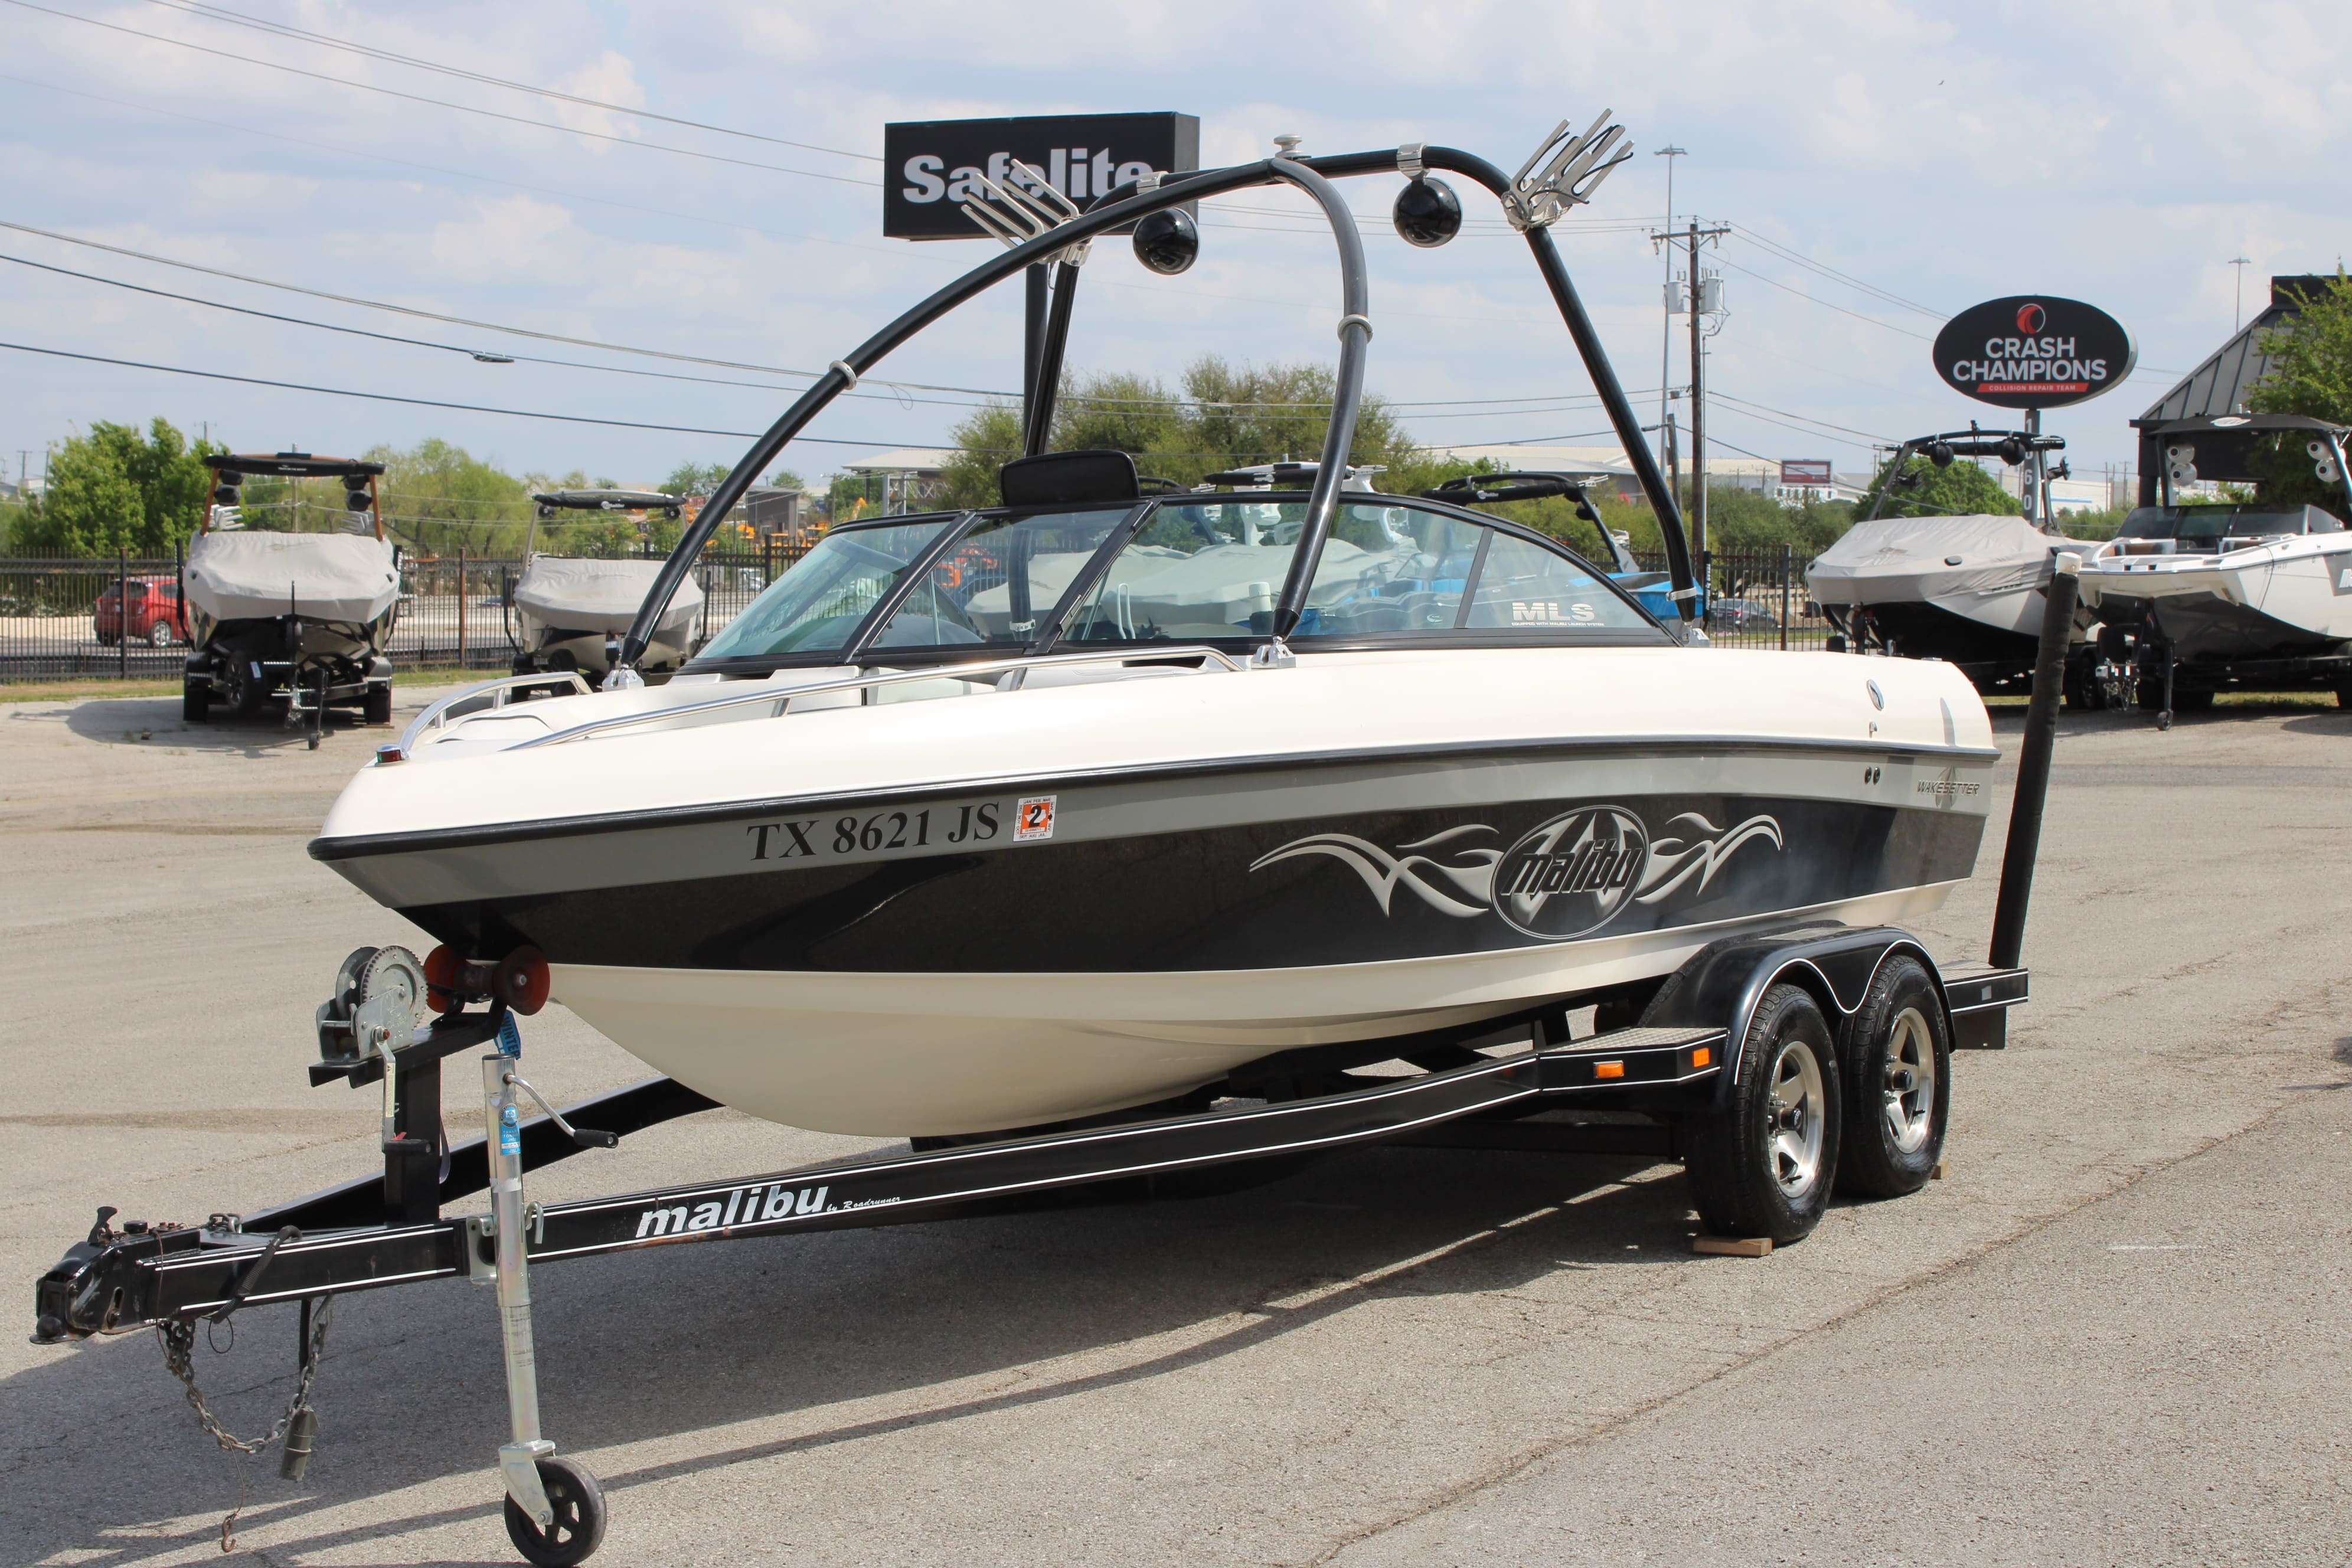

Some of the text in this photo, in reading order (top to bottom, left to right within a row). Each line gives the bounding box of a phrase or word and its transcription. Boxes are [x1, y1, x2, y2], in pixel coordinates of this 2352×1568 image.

[1985, 338, 2075, 358] CRASH
[1953, 360, 2107, 381] CHAMPIONS
[1512, 602, 1595, 621] MLS
[1917, 781, 1979, 795] WAKESETTER
[1029, 805, 1041, 827] 2
[747, 802, 1000, 860] TX 8621 JS
[1501, 838, 1644, 896] malibu
[635, 1185, 900, 1238] malibu by Roadrunner
